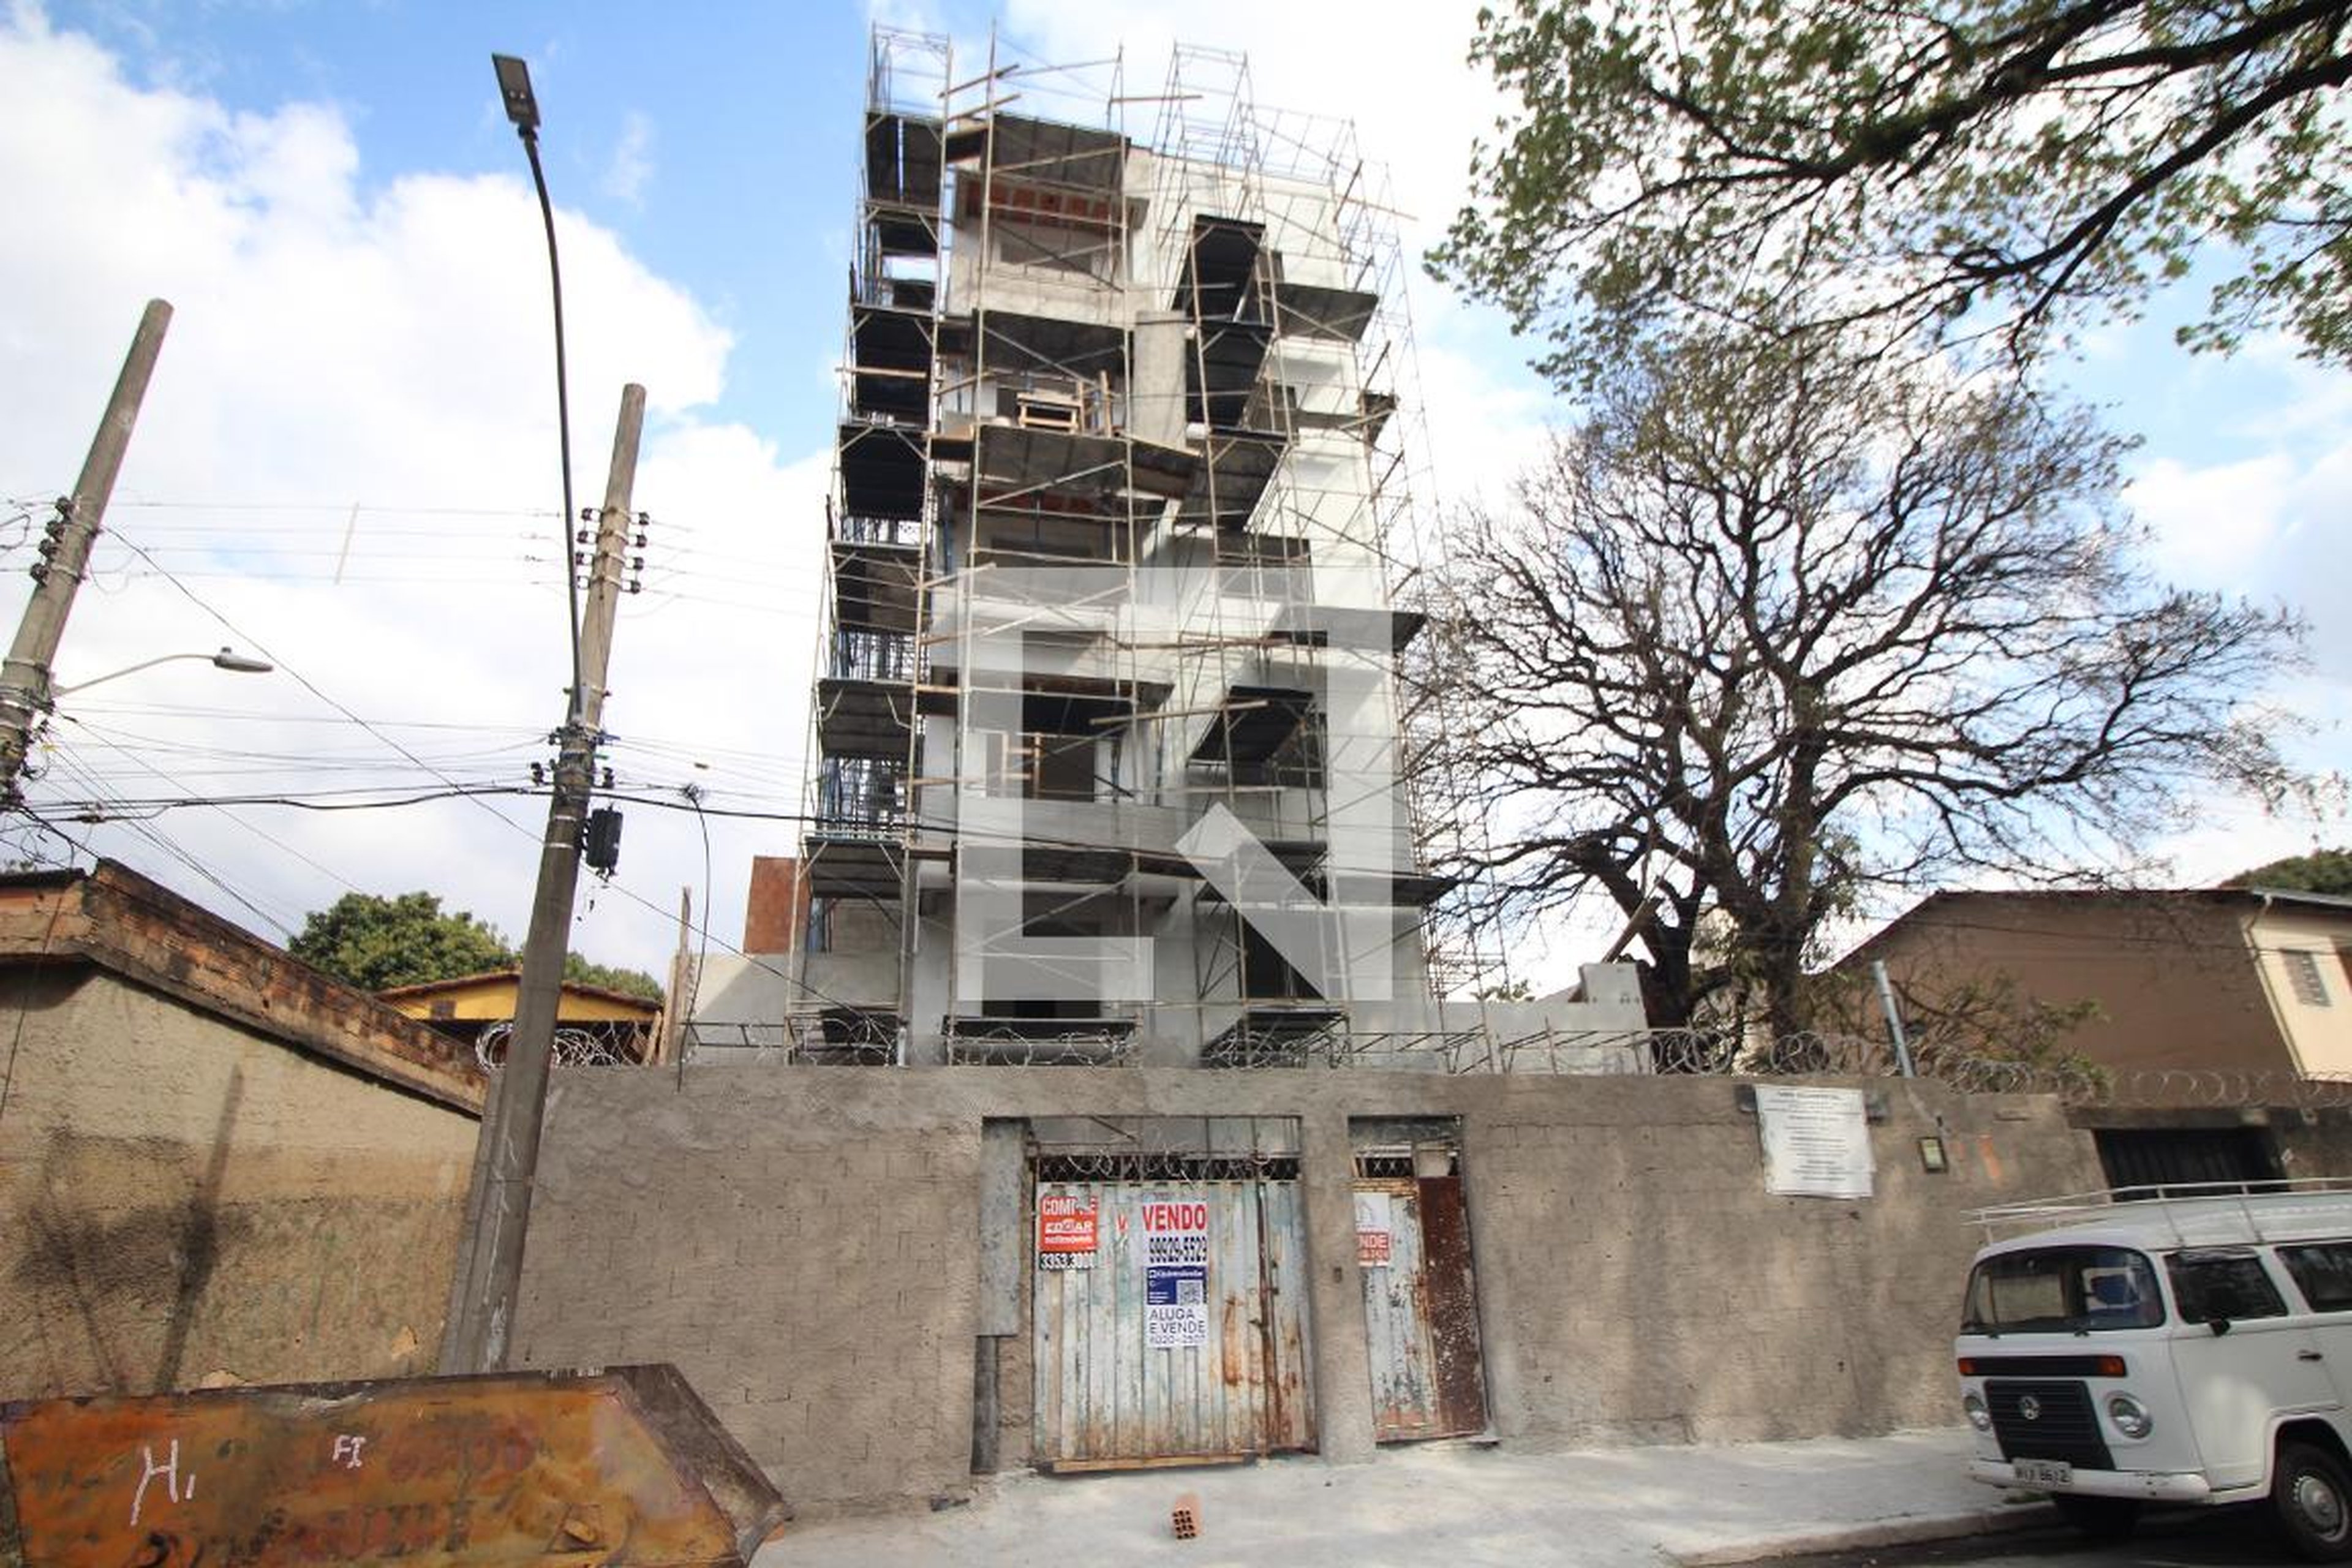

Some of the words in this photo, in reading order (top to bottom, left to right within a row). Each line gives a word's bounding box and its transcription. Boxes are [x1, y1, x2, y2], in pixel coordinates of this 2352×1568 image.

[1142, 1204, 1205, 1231] VENDO
[1359, 1234, 1387, 1248] NDE
[1150, 1308, 1195, 1321] ALUGA
[1150, 1322, 1157, 1333] E
[1161, 1320, 1205, 1333] VENDE
